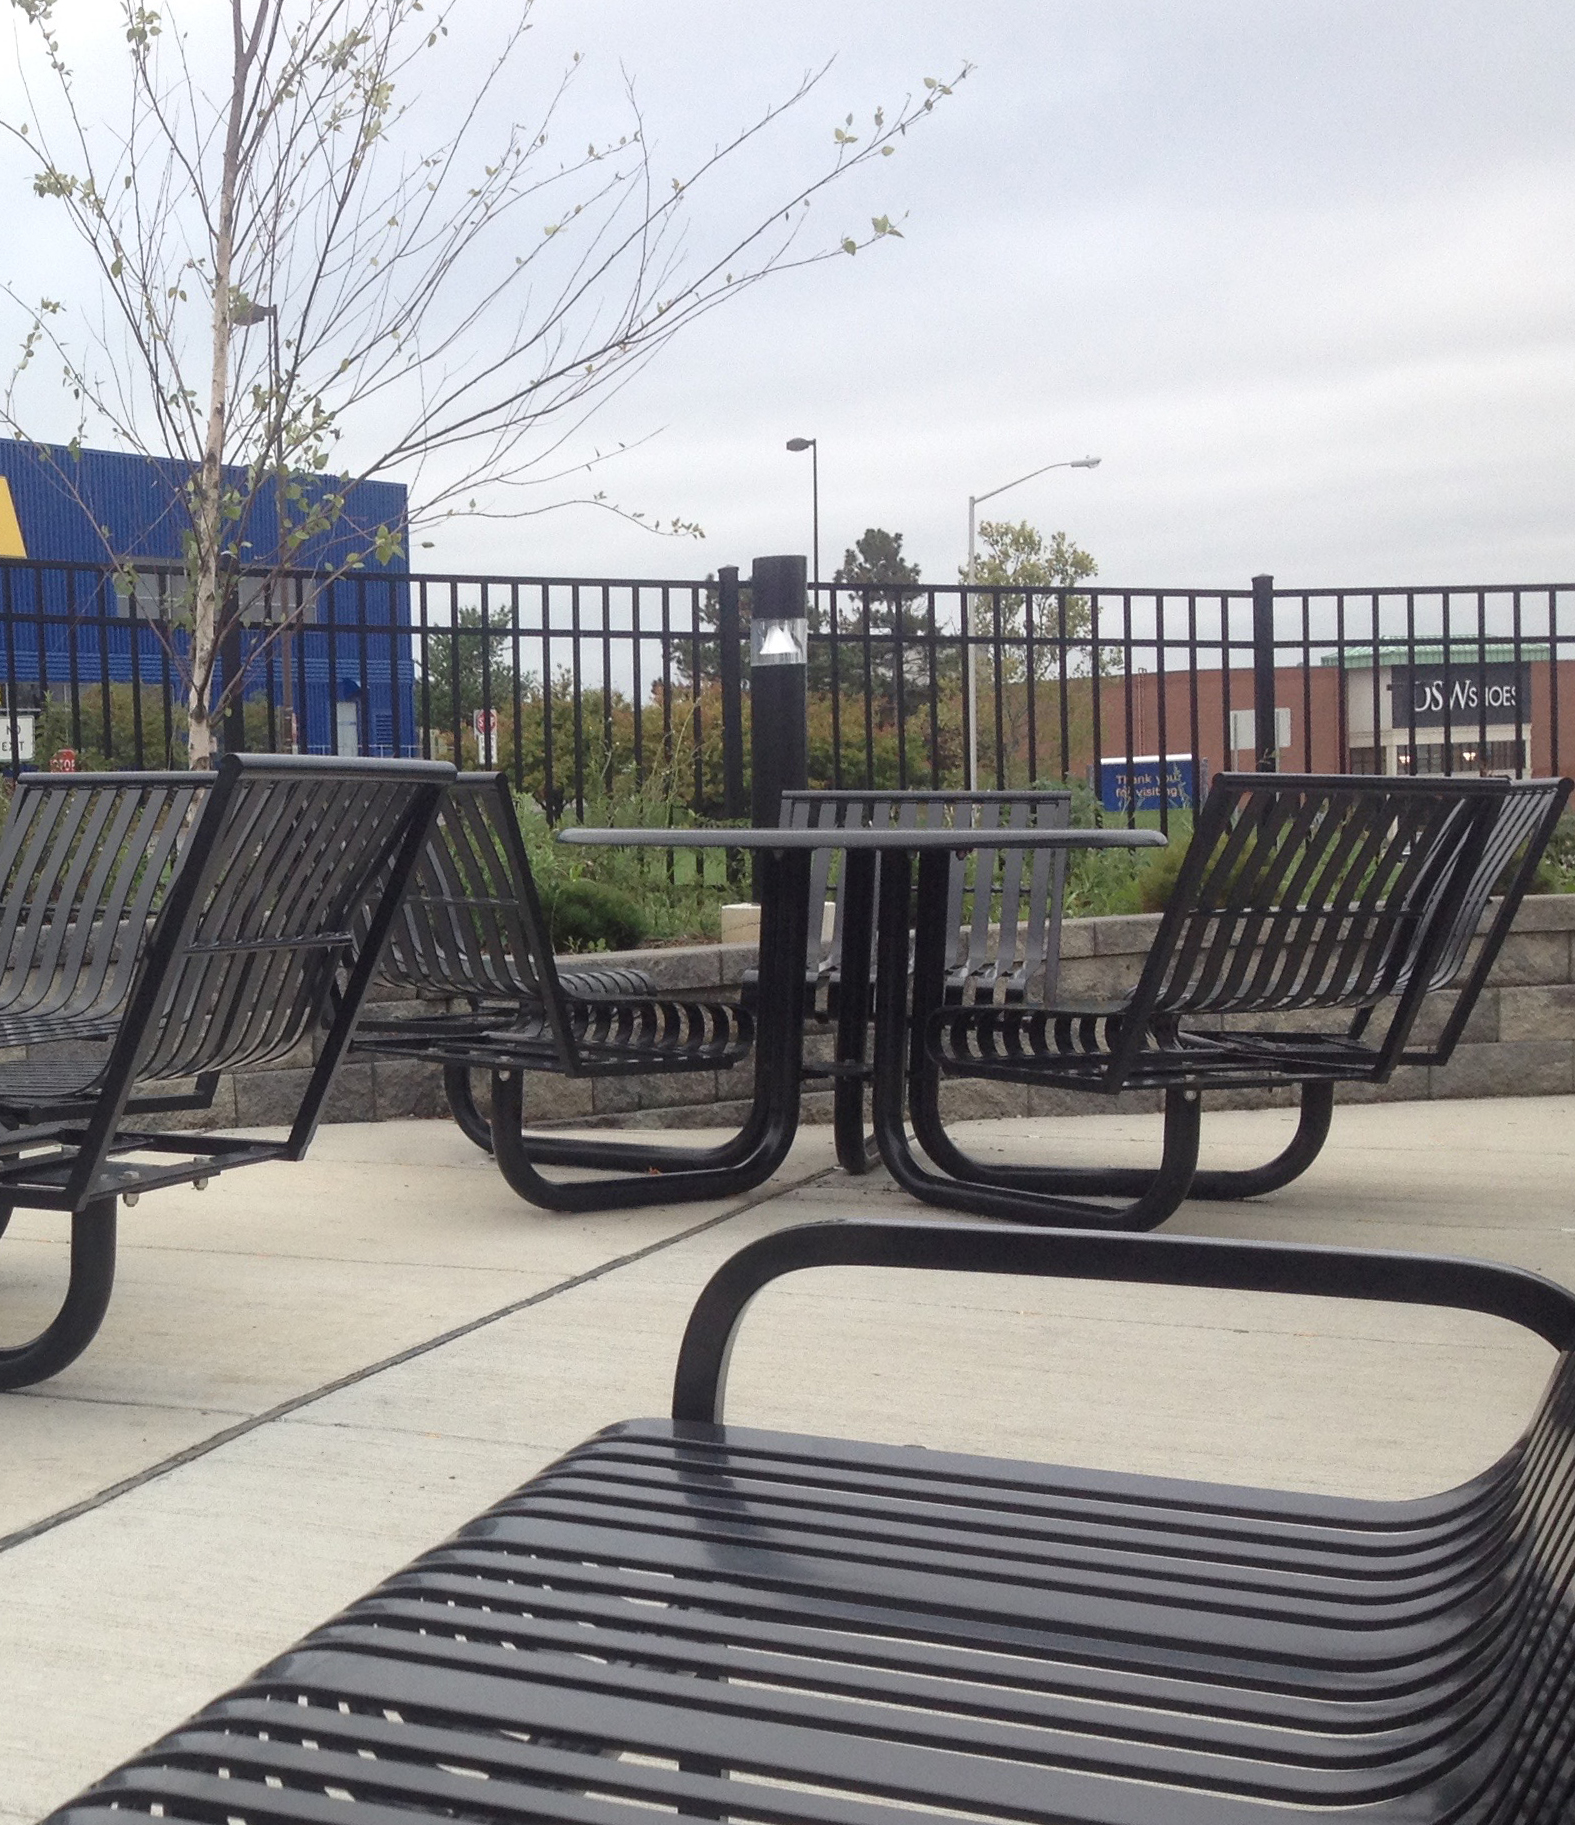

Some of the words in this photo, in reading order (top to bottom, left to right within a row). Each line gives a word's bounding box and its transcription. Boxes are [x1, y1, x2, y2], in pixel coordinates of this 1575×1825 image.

[1413, 680, 1471, 712] DSW
[2, 741, 25, 752] ET
[1136, 787, 1178, 798] visitng
